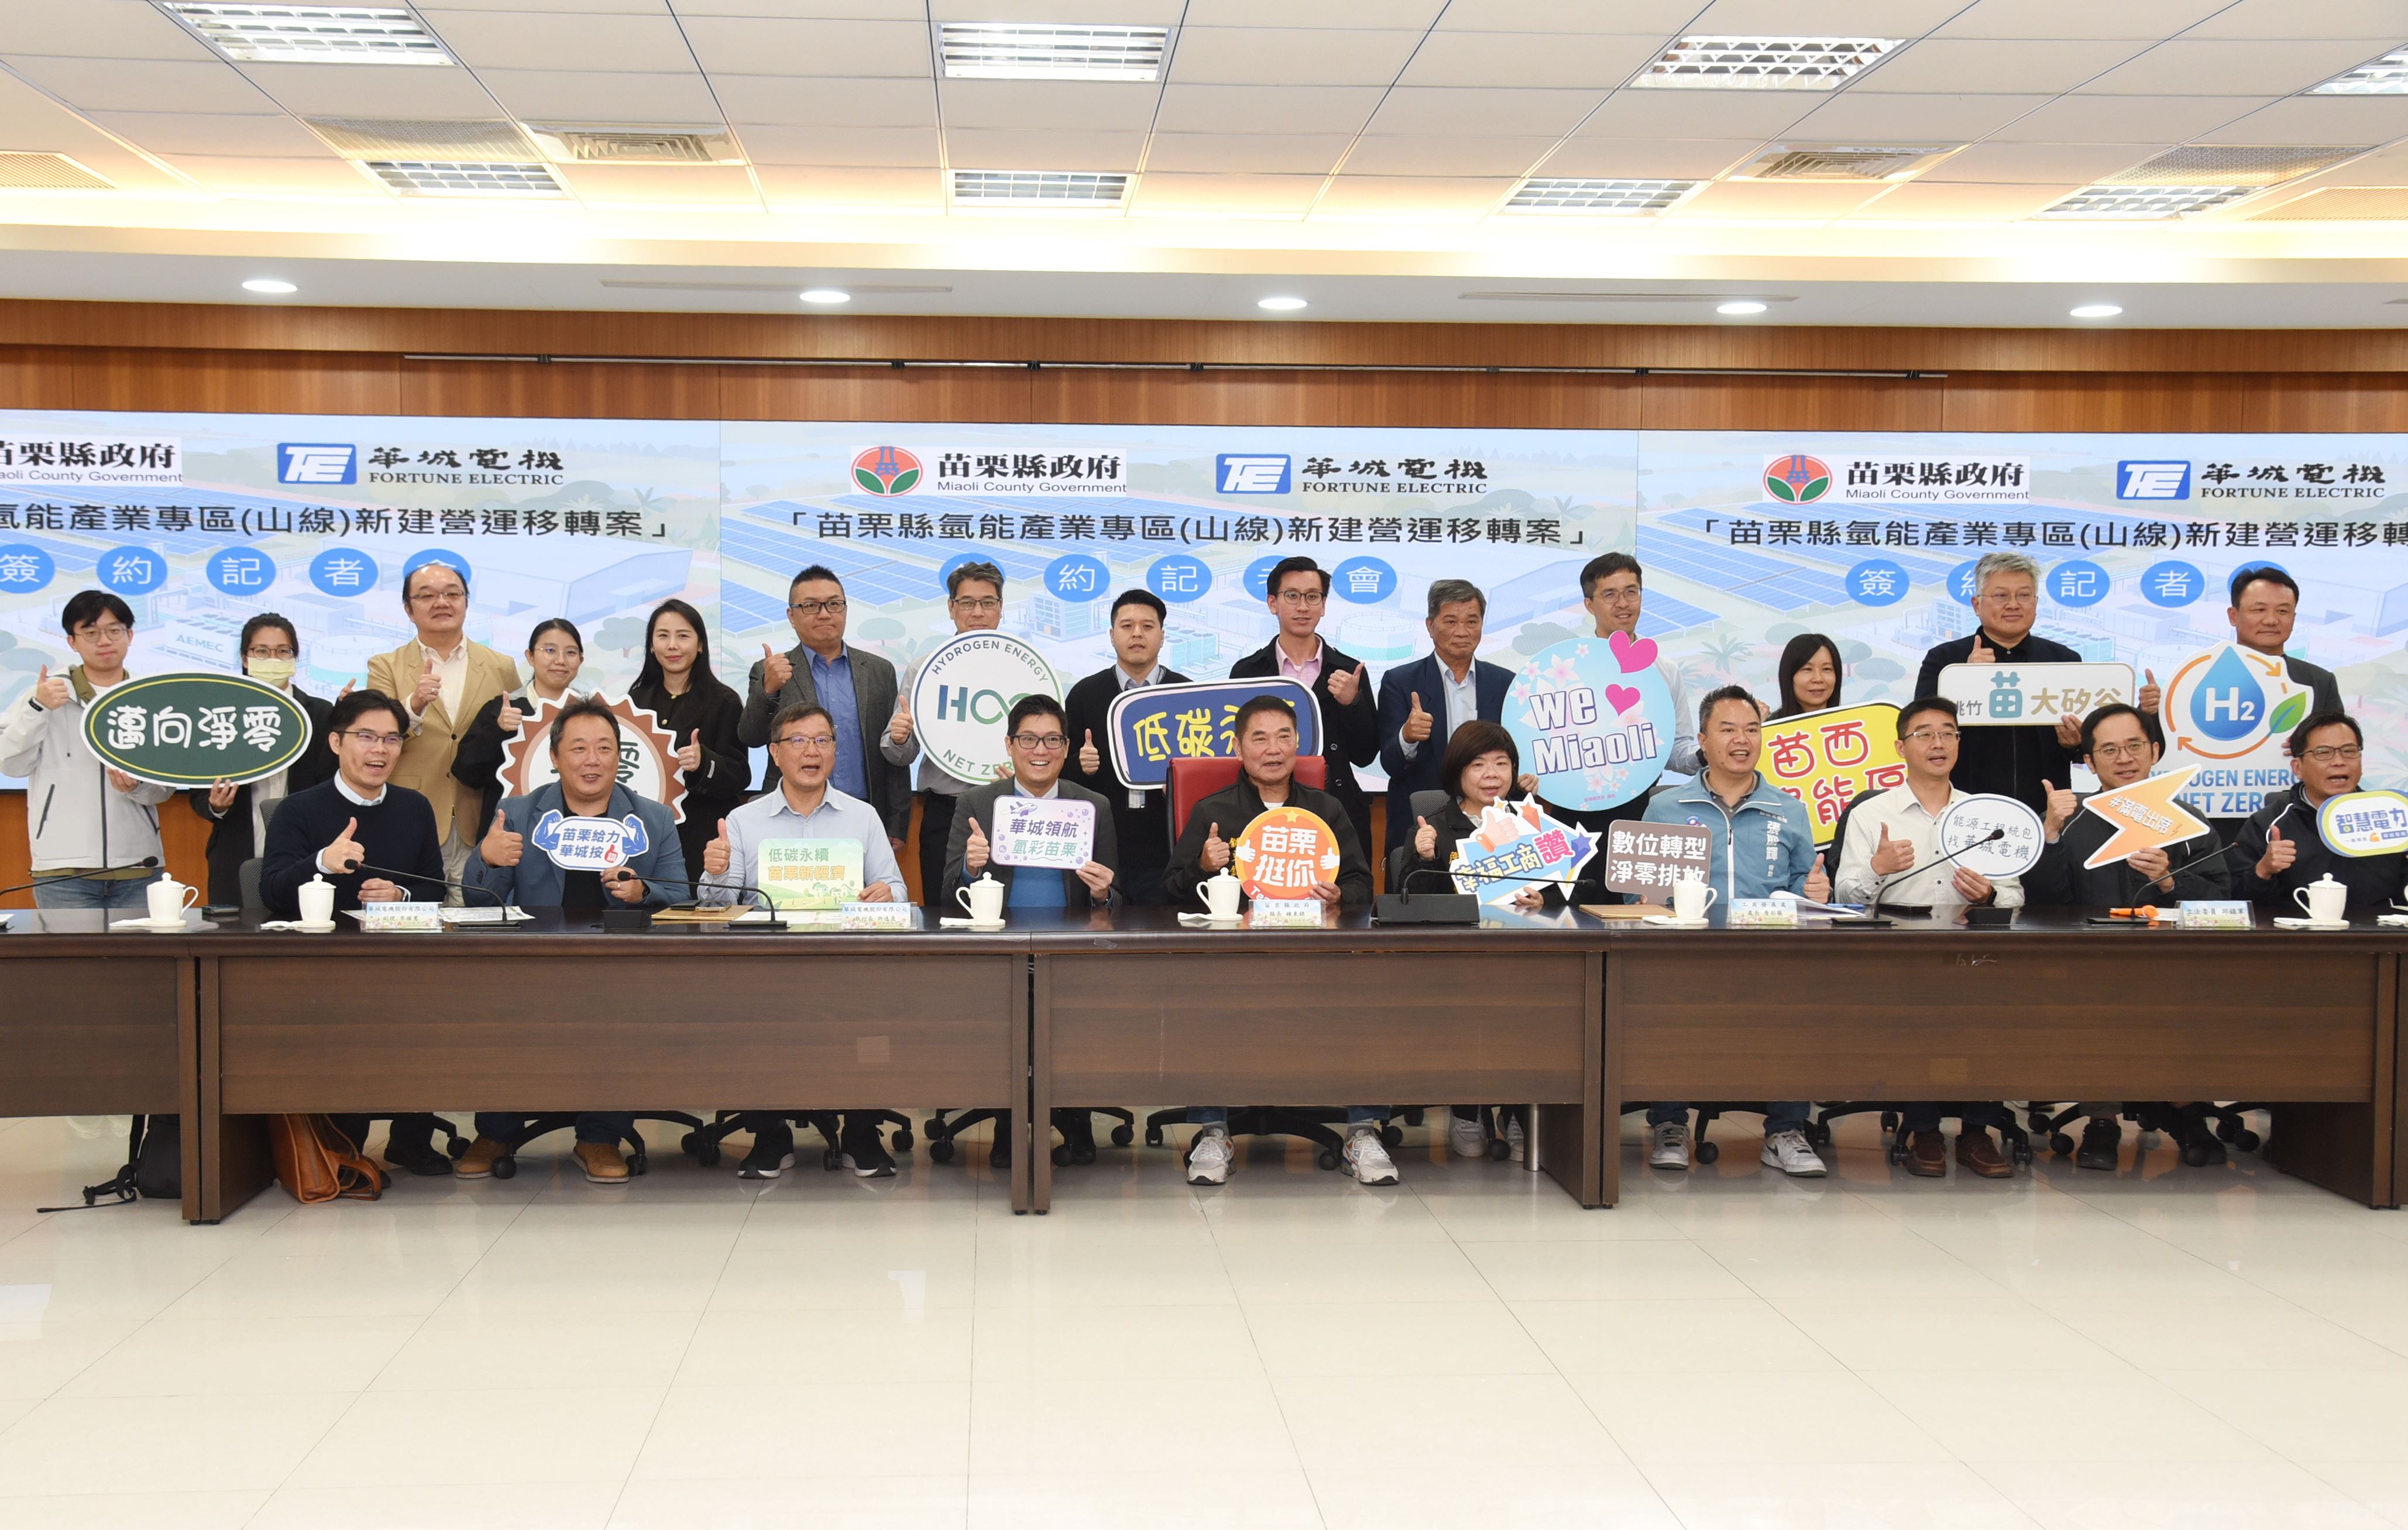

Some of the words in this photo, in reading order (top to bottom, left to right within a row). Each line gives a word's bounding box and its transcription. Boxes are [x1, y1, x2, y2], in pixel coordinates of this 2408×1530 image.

[369, 447, 564, 470] 華城電機
[937, 453, 1121, 480] 苗栗縣政府
[1302, 457, 1488, 479] 華城電機
[29, 470, 83, 483] County
[88, 471, 183, 483] Government
[369, 472, 462, 484] FORTUNE
[469, 473, 564, 485] ELECTRIC
[1846, 461, 2024, 487] 苗栗縣政府
[2201, 463, 2386, 484] 華城電機
[937, 482, 979, 491] Miaoli
[984, 482, 1035, 494] County
[1039, 482, 1127, 493] Government
[1303, 482, 1391, 493] FORTUNE
[1397, 483, 1487, 493] ELECTRIC
[1846, 489, 1886, 500] Miaoli
[1891, 489, 1939, 501] County
[1944, 490, 2029, 500] Government
[2201, 487, 2289, 498] FORTUNE
[2295, 488, 2385, 498] ELECTRIC
[932, 641, 999, 675] HYDROGEN
[1004, 644, 1049, 683] ENERGY
[107, 706, 282, 752] 邁向淨零
[1532, 723, 1657, 775] Miaoli
[1768, 721, 1868, 778] 苗西
[943, 749, 975, 772] NET
[981, 760, 1015, 776] ZER
[2221, 792, 2265, 813] ZER
[1009, 818, 1079, 838] 華城領航
[1953, 814, 2032, 840] 能源工程統包
[2335, 808, 2407, 834] 智慧電力
[562, 828, 620, 843] 苗栗給力
[1262, 825, 1318, 856] 苗栗
[1612, 830, 1707, 860] 數位轉型
[768, 848, 829, 862] 低碳永續
[1012, 838, 1078, 857] 氫彩苗栗
[768, 865, 846, 881] 苗栗新經濟
[1253, 854, 1318, 888] 挺你
